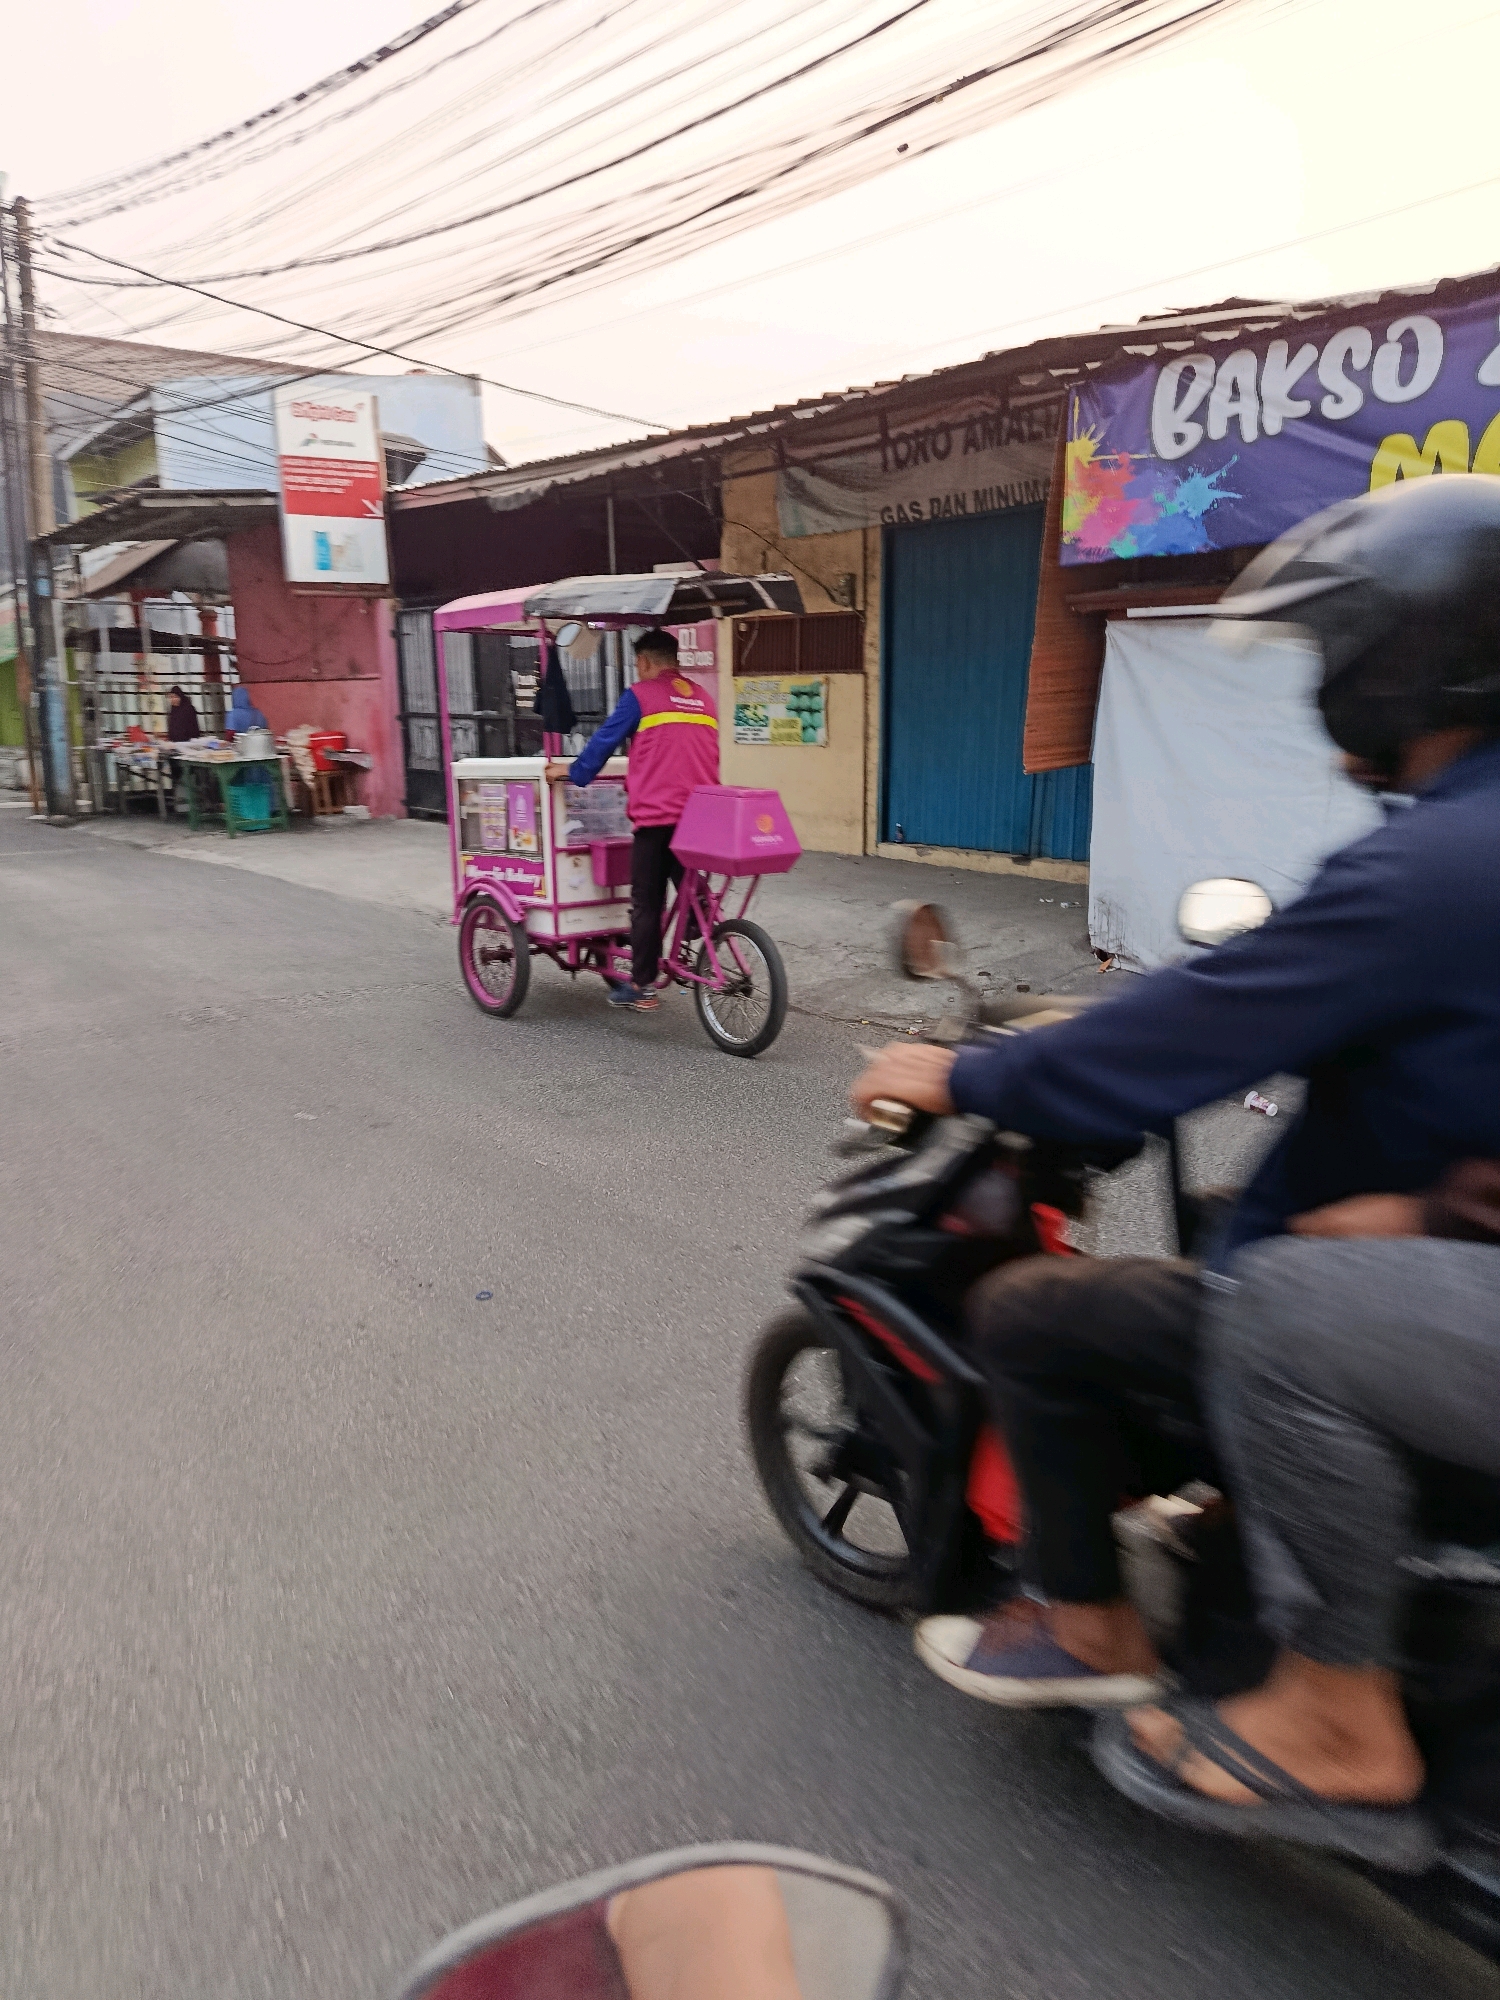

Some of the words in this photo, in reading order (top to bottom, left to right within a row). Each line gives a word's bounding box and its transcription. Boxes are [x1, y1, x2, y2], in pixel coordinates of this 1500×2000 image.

[1152, 315, 1443, 460] BAKSO
[963, 406, 1060, 455] AMALI
[881, 501, 923, 525] GAS
[930, 492, 967, 520] DAN
